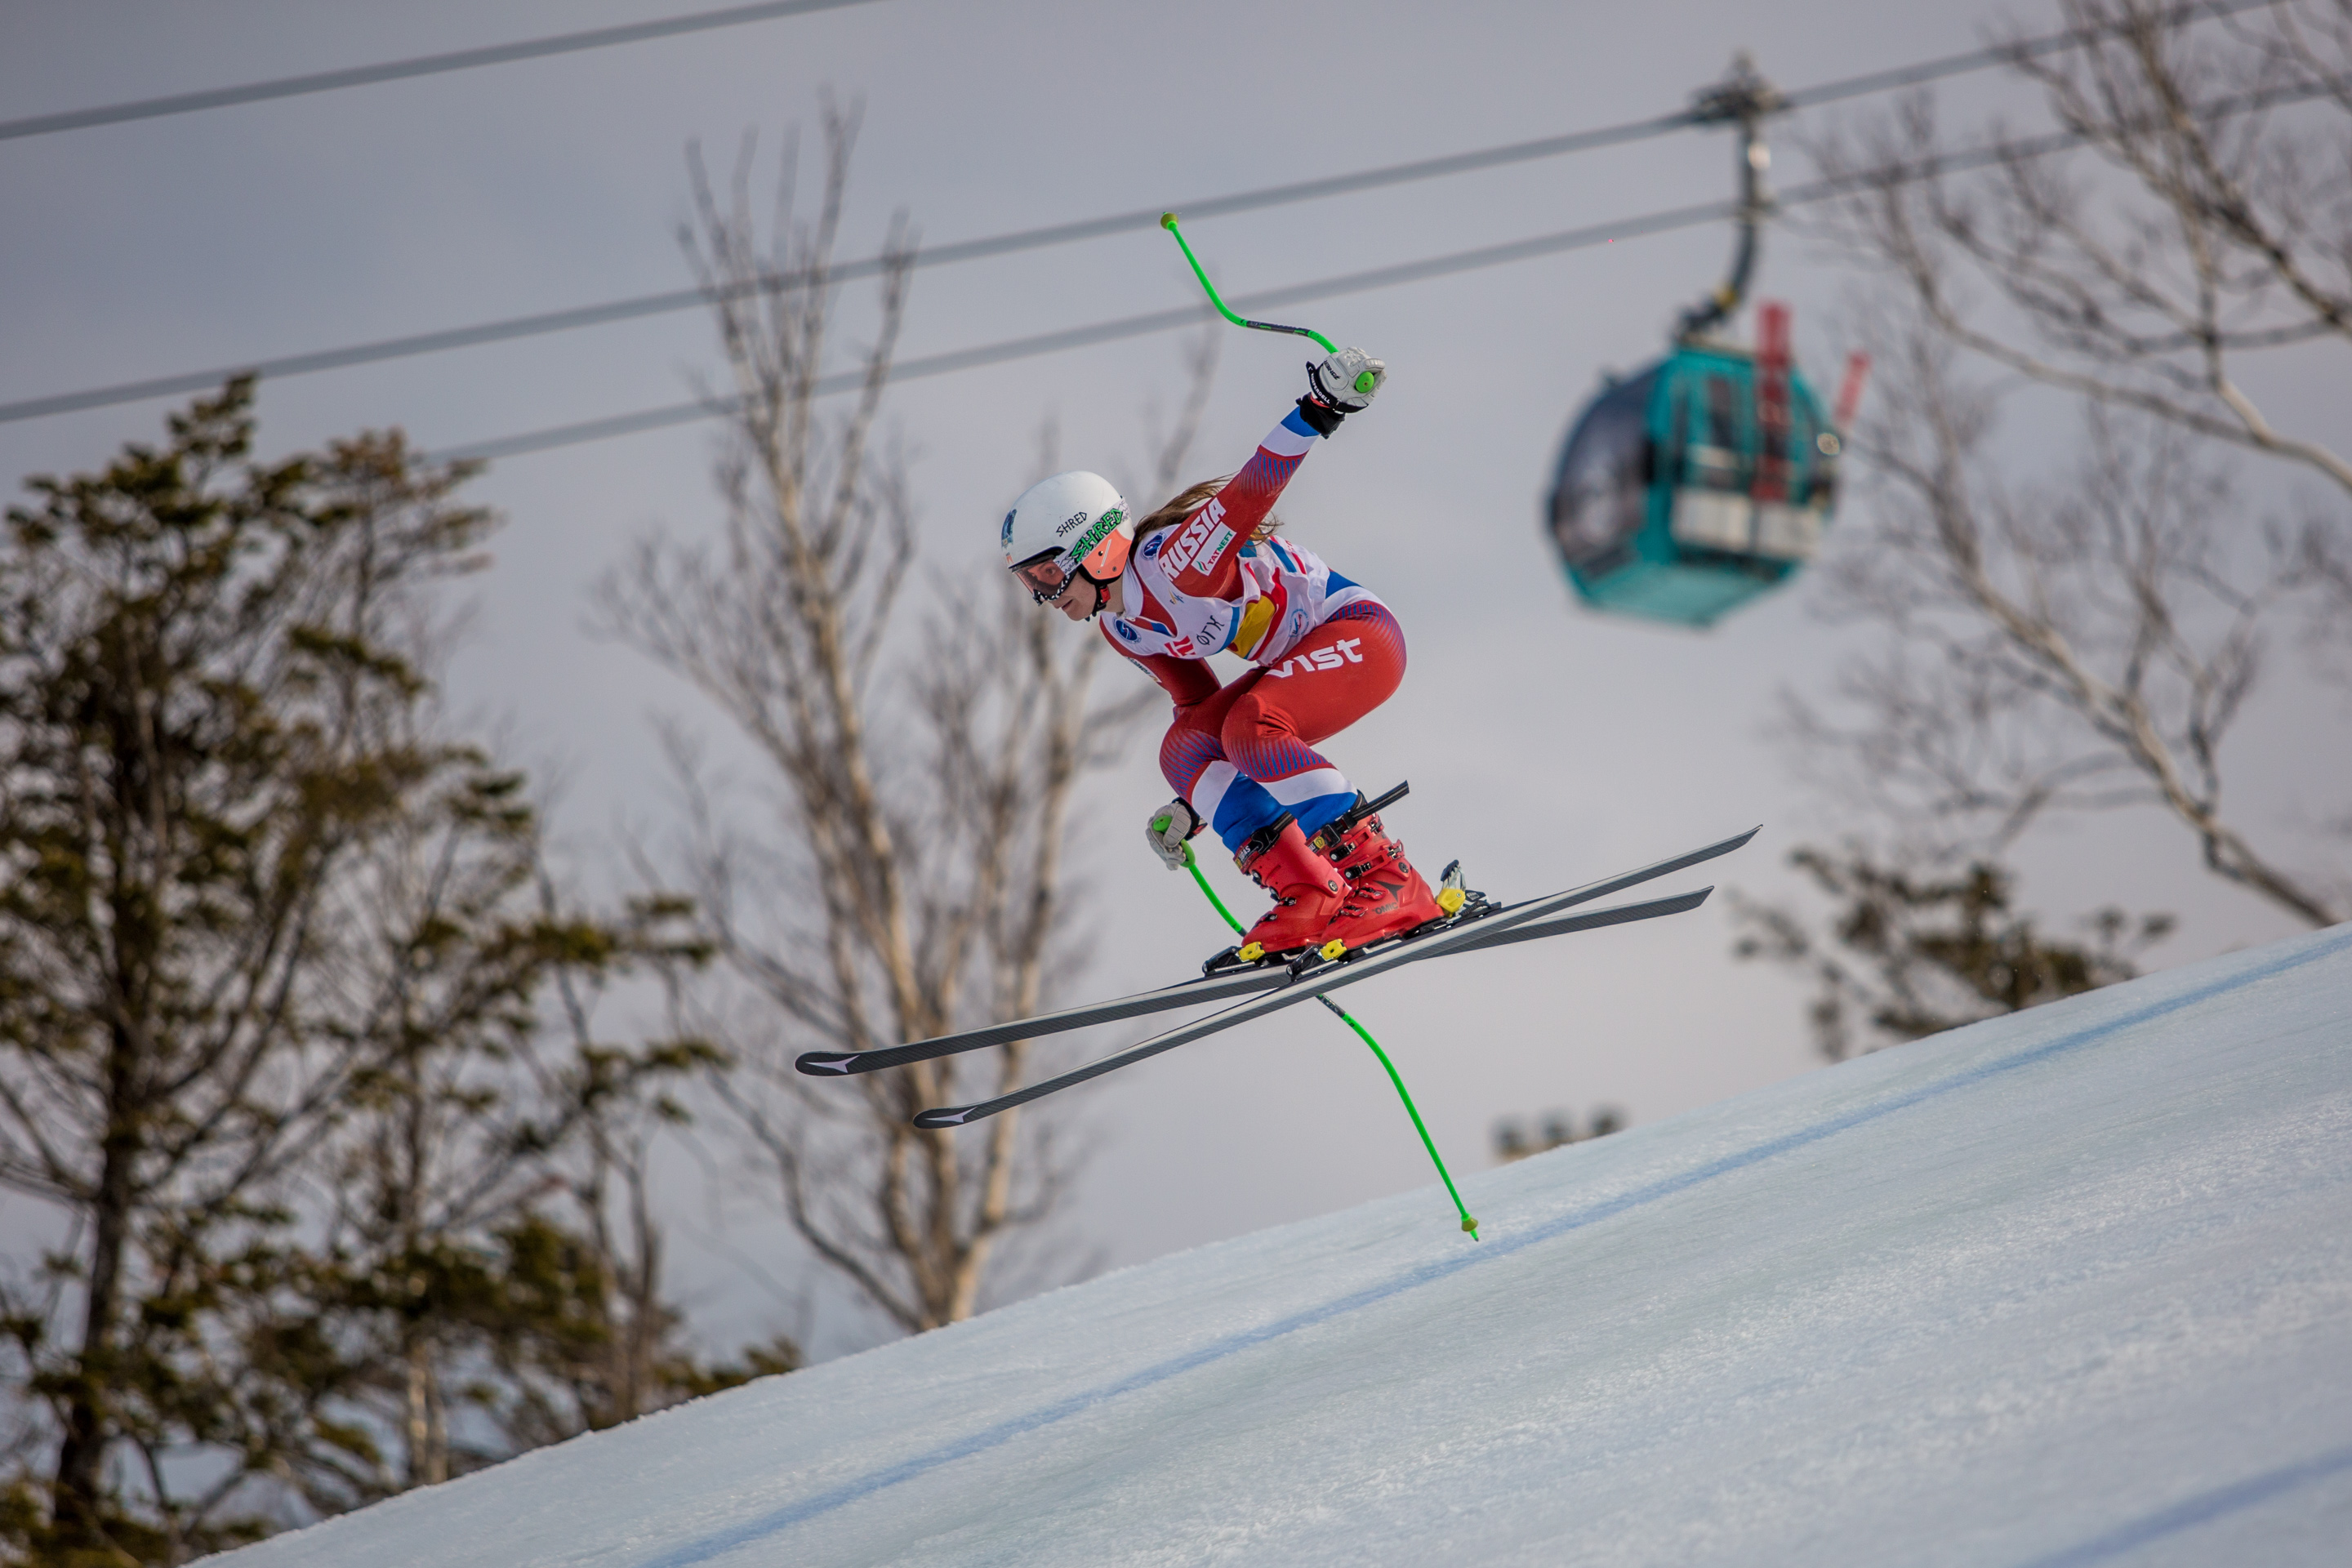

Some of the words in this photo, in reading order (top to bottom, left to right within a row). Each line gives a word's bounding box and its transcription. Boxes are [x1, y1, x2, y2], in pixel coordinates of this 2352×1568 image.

[1055, 511, 1087, 537] SHRED
[1071, 507, 1124, 564] SHRED
[1158, 497, 1227, 581] RUSSIA
[1207, 530, 1233, 565] TATNEFT
